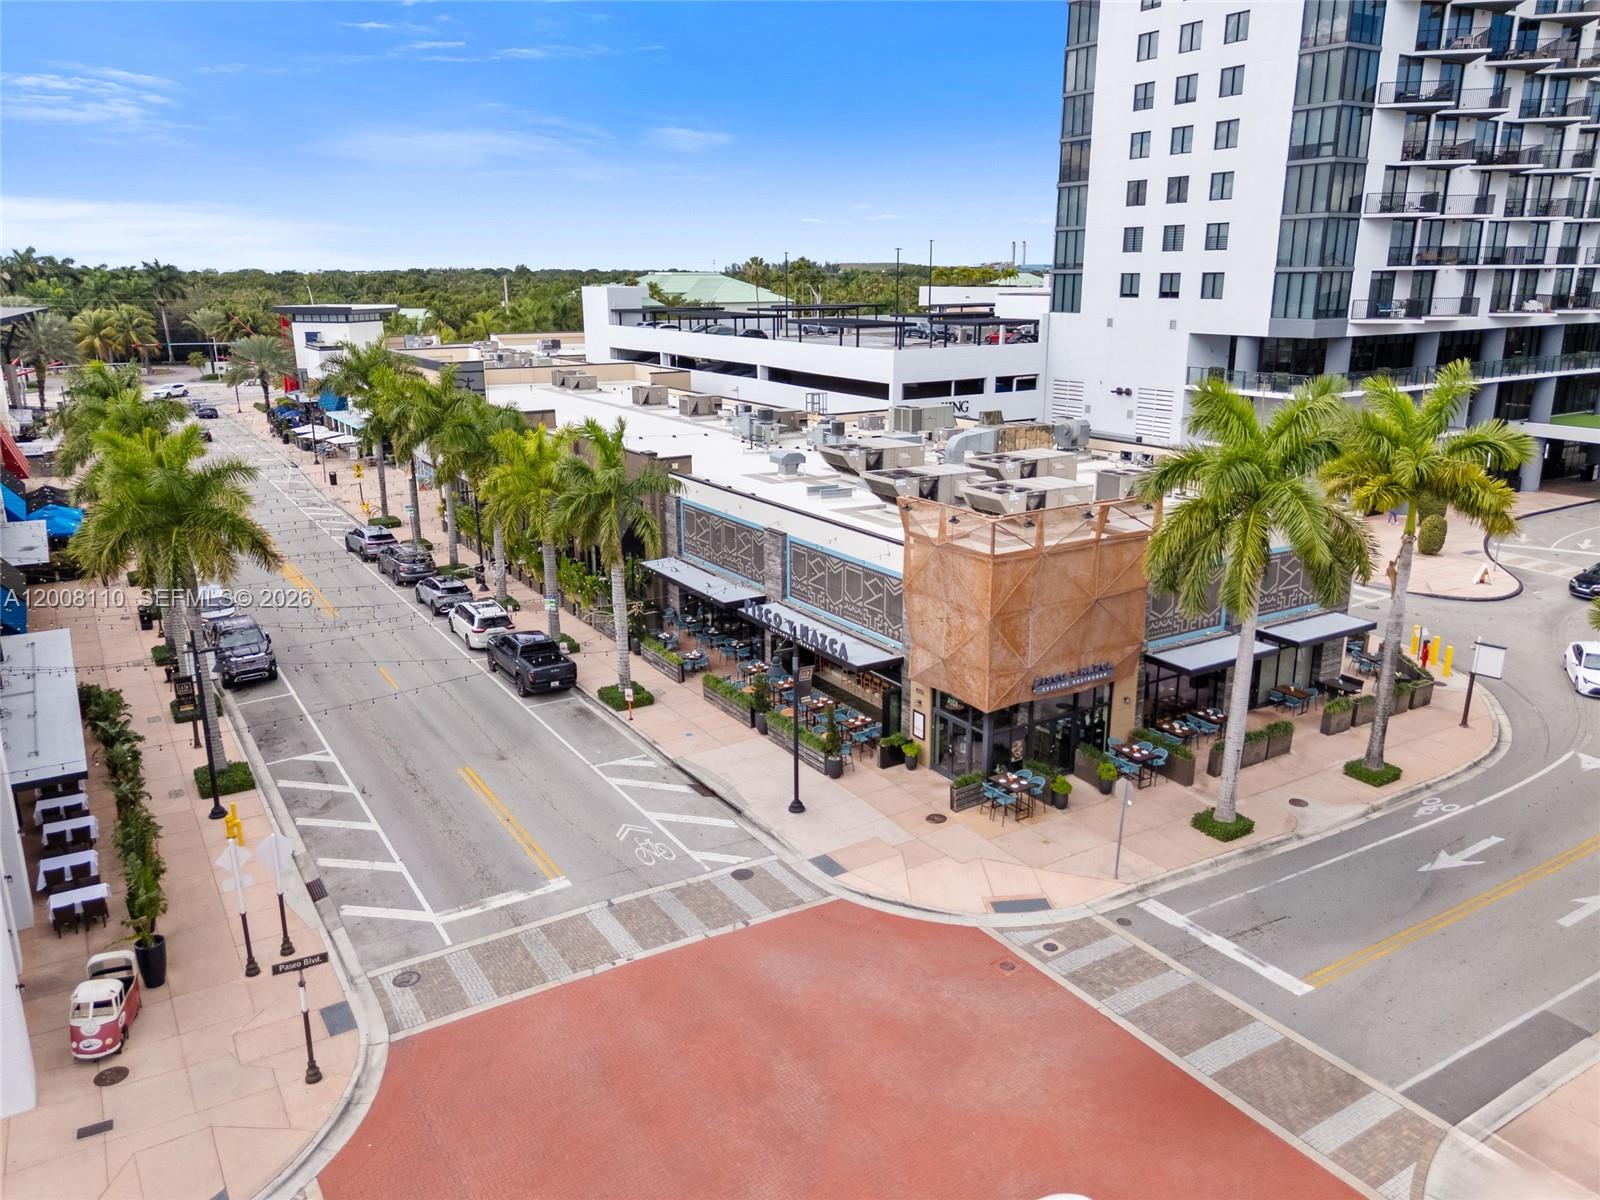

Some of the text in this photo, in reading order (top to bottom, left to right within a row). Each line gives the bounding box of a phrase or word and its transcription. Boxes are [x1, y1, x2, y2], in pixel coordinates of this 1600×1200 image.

[744, 600, 783, 628] PISCO
[799, 624, 849, 661] NAZCA
[279, 957, 322, 972] Paseo Blvd.
